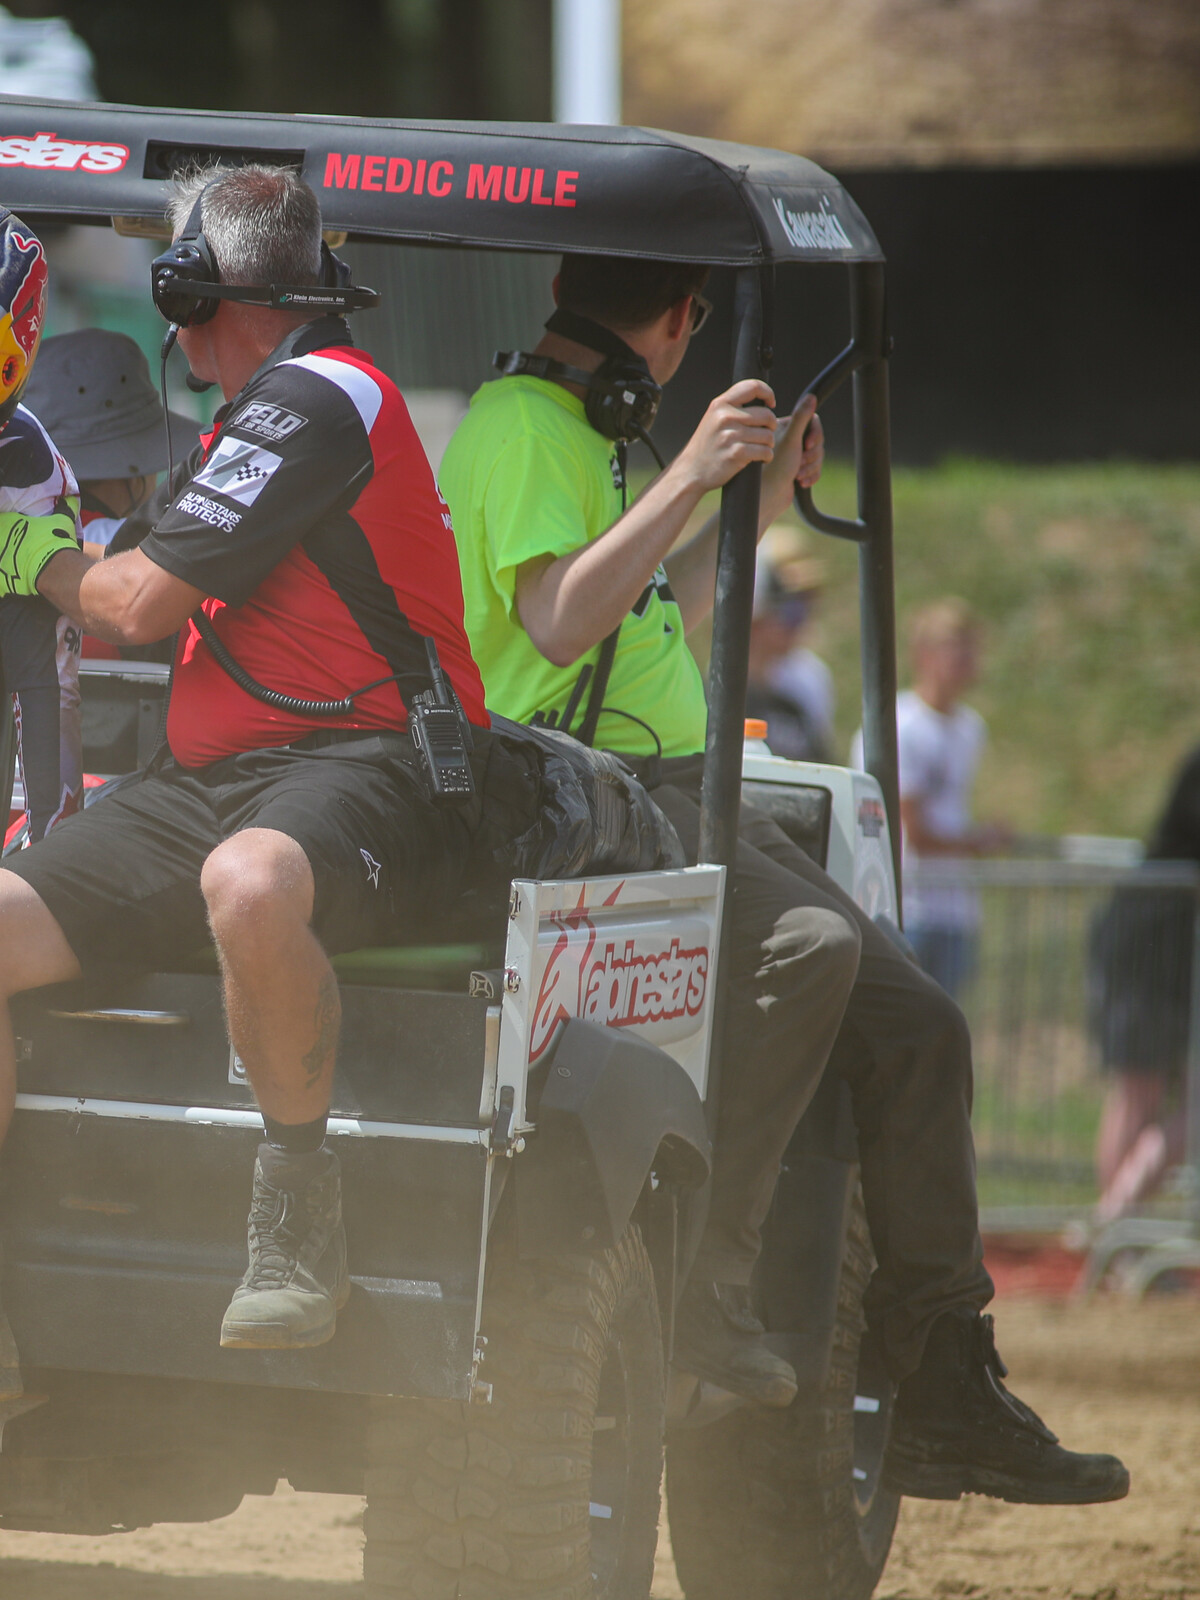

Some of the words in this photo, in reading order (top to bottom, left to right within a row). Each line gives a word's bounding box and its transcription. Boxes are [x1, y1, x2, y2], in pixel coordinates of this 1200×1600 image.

[323, 152, 454, 198] MEDIC
[465, 163, 580, 208] MULE
[238, 403, 302, 435] FELD
[254, 425, 285, 440] SPORTS
[176, 499, 236, 533] PROTECTS
[184, 491, 243, 524] ALPINESTARS
[583, 937, 709, 1028] alpinestars
